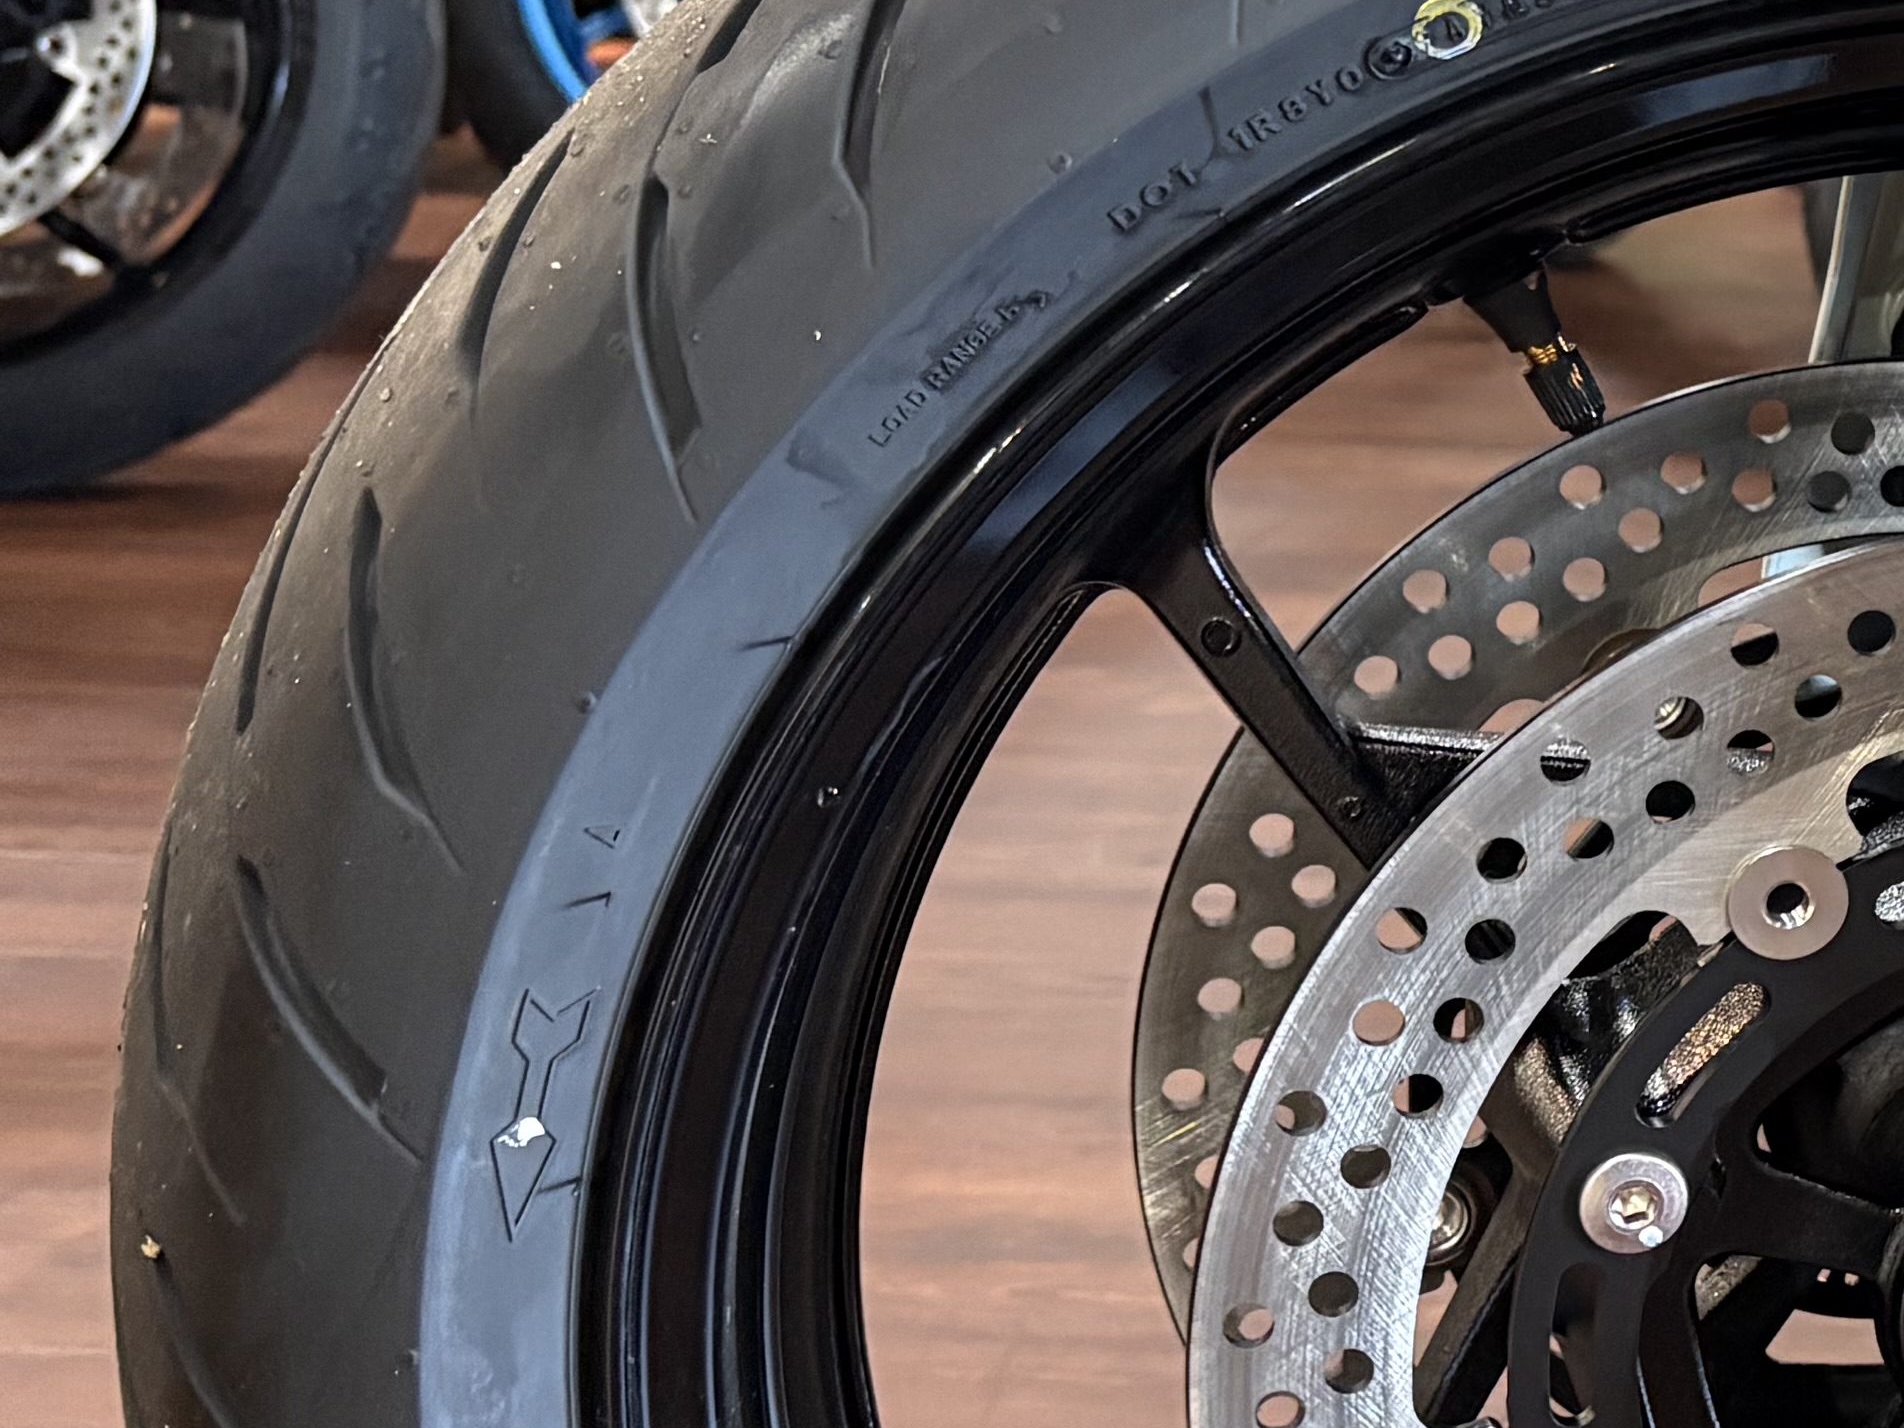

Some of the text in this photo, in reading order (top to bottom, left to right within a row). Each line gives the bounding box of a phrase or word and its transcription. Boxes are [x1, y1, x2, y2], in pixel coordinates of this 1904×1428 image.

[1105, 156, 1200, 235] DOT
[867, 388, 927, 449] LOAD
[925, 319, 1003, 391] RANGE
